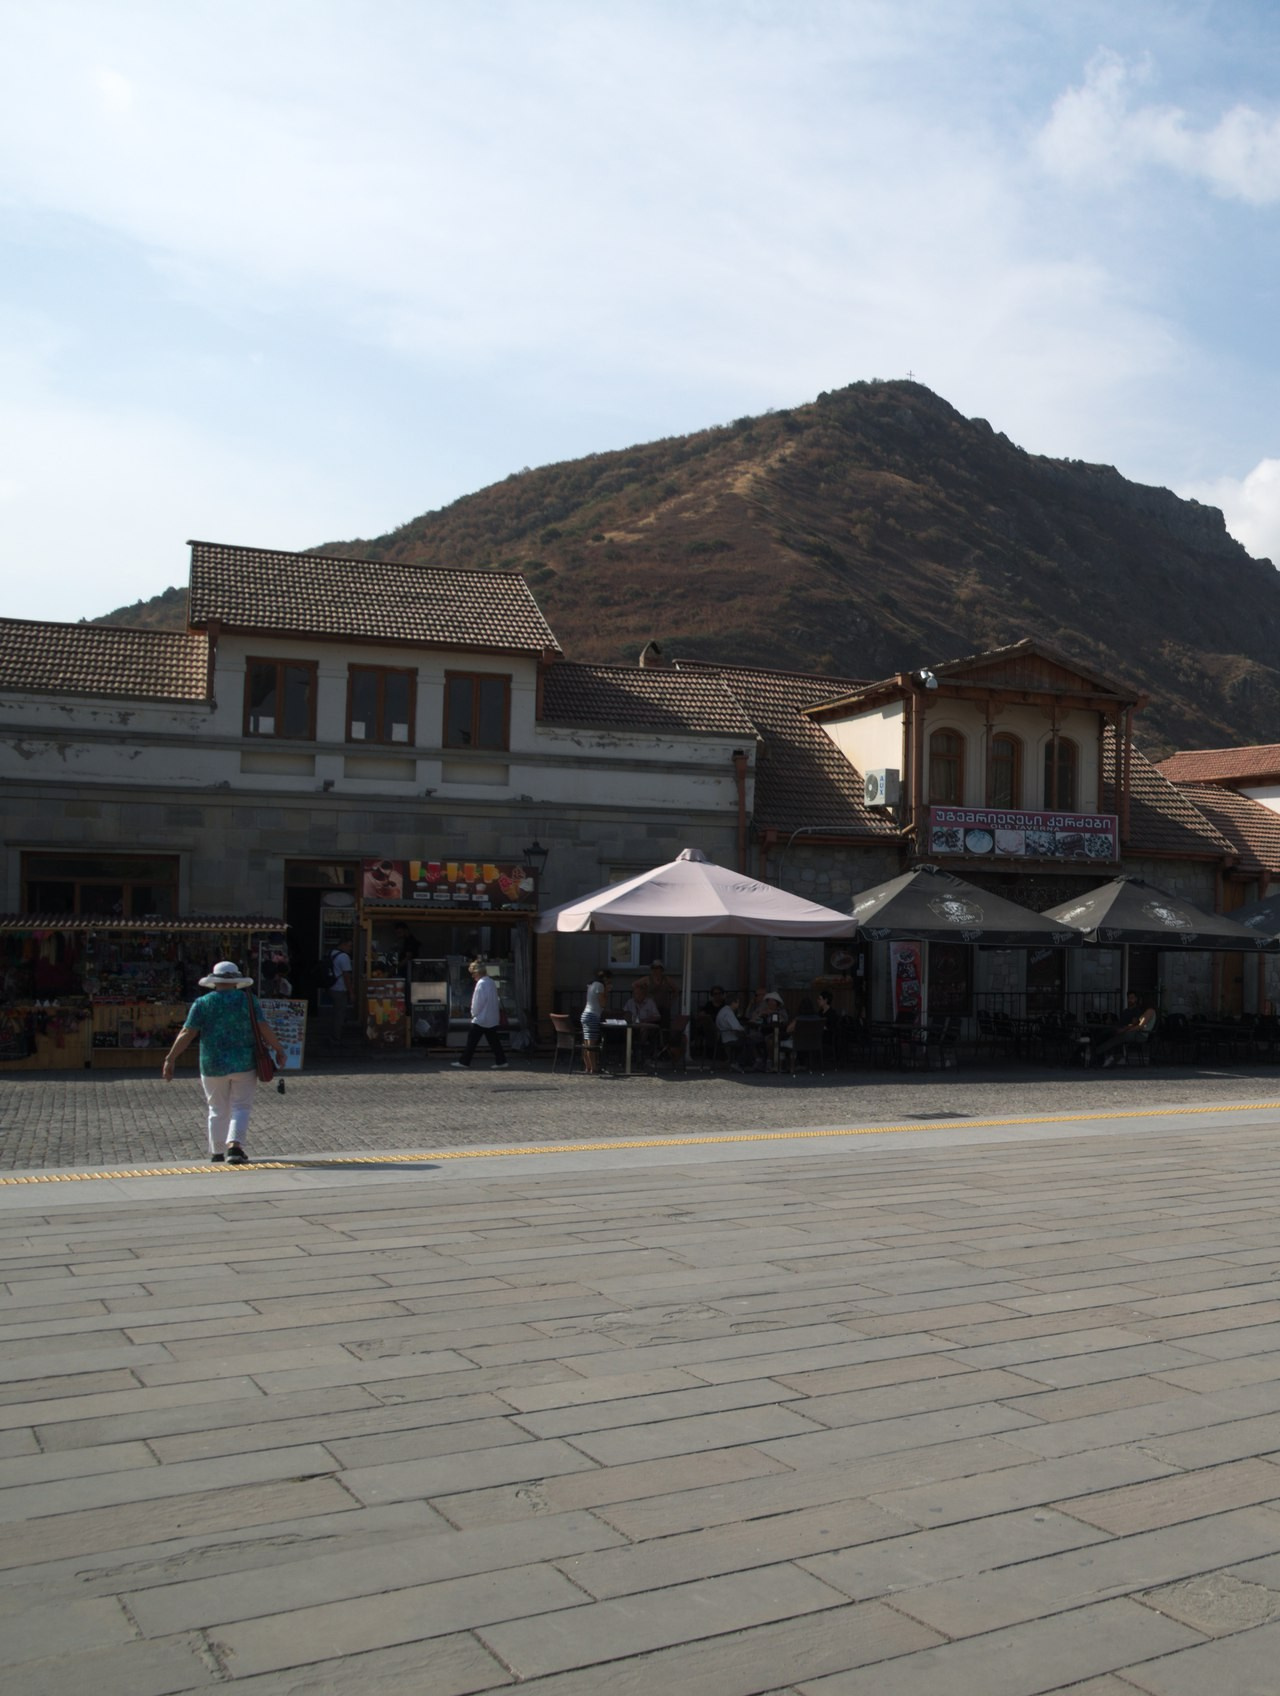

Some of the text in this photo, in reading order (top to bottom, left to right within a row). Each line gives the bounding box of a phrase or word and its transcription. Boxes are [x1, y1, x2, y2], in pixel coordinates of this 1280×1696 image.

[936, 811, 1112, 829] უგემრიელესი კერძები
[1014, 824, 1060, 832] TAVERNA
